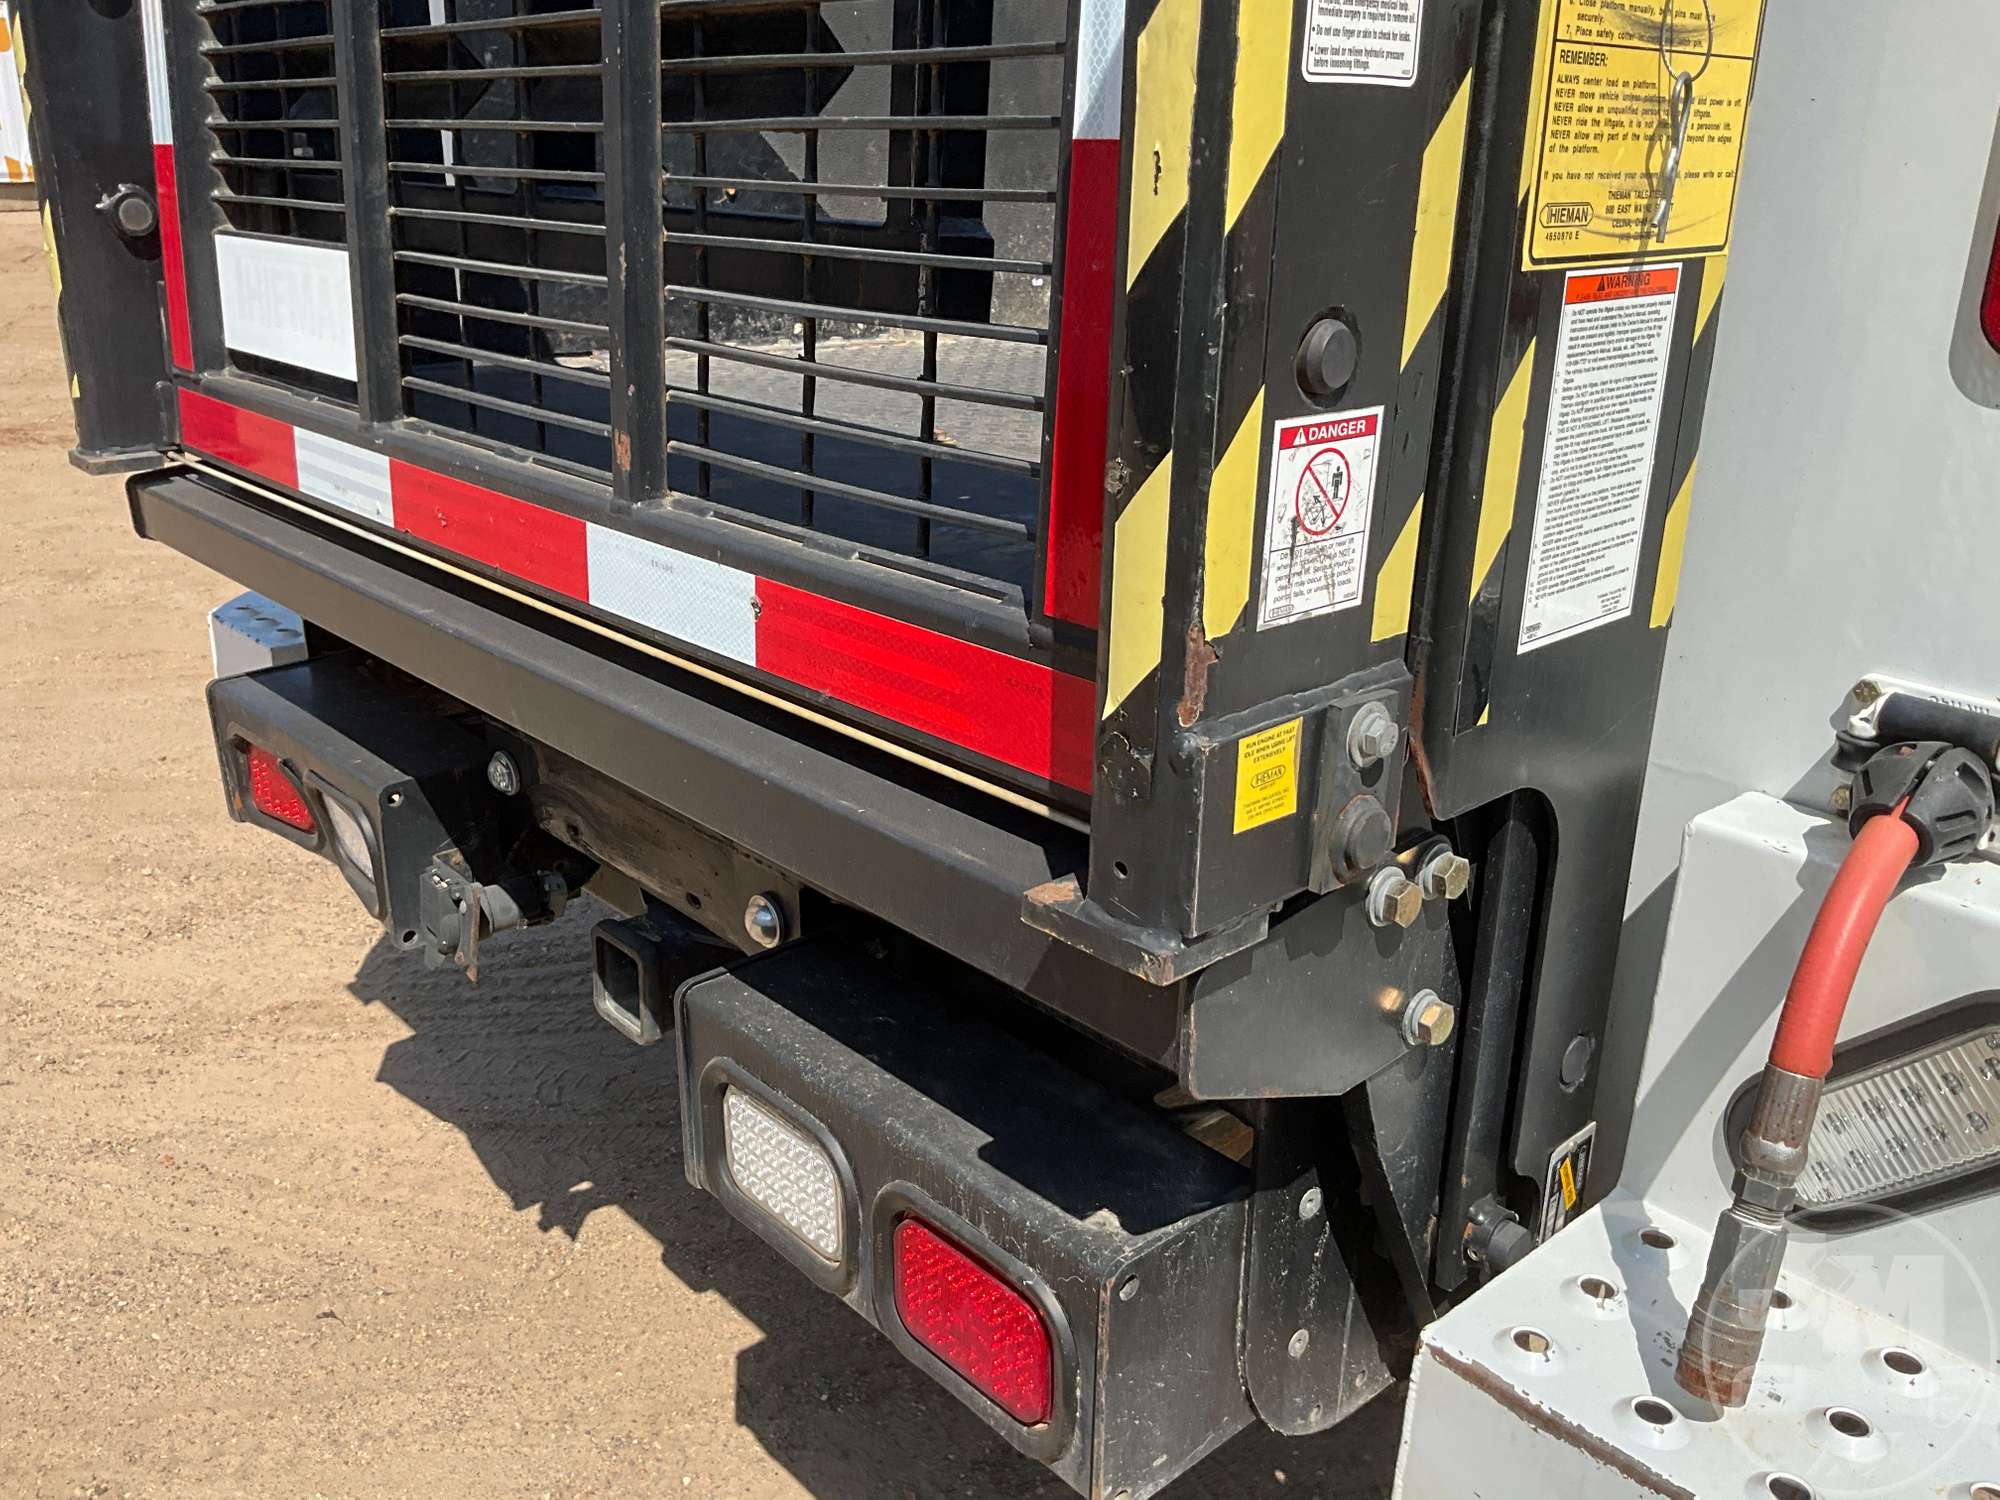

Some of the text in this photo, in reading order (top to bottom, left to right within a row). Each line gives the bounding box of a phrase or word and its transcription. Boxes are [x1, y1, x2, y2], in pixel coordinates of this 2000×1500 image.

[1579, 0, 1597, 8] Close
[1675, 8, 1686, 19] pins
[1689, 11, 1703, 21] must
[1316, 24, 1323, 36] Do
[1324, 26, 1332, 37] not
[1332, 28, 1341, 37] use
[1342, 26, 1356, 40] finger
[1378, 29, 1391, 40] check
[1576, 25, 1593, 37] Place
[1596, 29, 1615, 41] safety
[1315, 44, 1329, 55] Lower
[1330, 45, 1341, 56] load
[1364, 48, 1385, 60] hydraulic
[1560, 49, 1608, 67] REMEMBER:
[1314, 57, 1329, 68] before
[1557, 74, 1657, 90] ALWAYS center load on platform.
[1555, 88, 1576, 99] NEVER
[1579, 91, 1595, 100] move
[1600, 91, 1619, 101] vehicle
[1710, 98, 1724, 107] power
[1554, 101, 1574, 112] NEVER
[1578, 103, 1593, 113] allow
[1597, 105, 1604, 113] an
[1608, 105, 1638, 116] unqualified
[1552, 115, 1572, 126] NEVER
[1576, 117, 1588, 127] ride
[1591, 119, 1600, 127] the
[1645, 120, 1654, 129] not
[1697, 123, 1721, 131] personnel
[1550, 130, 1571, 140] NEVER
[1574, 131, 1590, 141] allow
[1593, 133, 1604, 142] any
[1607, 132, 1619, 142] part
[1622, 131, 1629, 141] of
[1631, 132, 1640, 141] the
[1686, 135, 1705, 144] beyond
[1707, 135, 1715, 143] the
[1717, 136, 1732, 145] edges
[1549, 143, 1600, 155] of the platform.
[1552, 172, 1563, 182] you
[1567, 171, 1581, 180] have
[1585, 172, 1594, 180] not
[1597, 171, 1621, 180] received
[1624, 173, 1637, 181] your
[1684, 170, 1700, 179] please
[1703, 170, 1715, 179] write
[1717, 171, 1723, 179] or
[1617, 204, 1631, 214] EAST
[1574, 230, 1580, 240] E
[1606, 273, 1651, 290] WARNING
[1309, 419, 1366, 441] DANGER
[1338, 547, 1351, 557] NOT
[1294, 580, 1306, 588] may
[1307, 575, 1323, 585] occur
